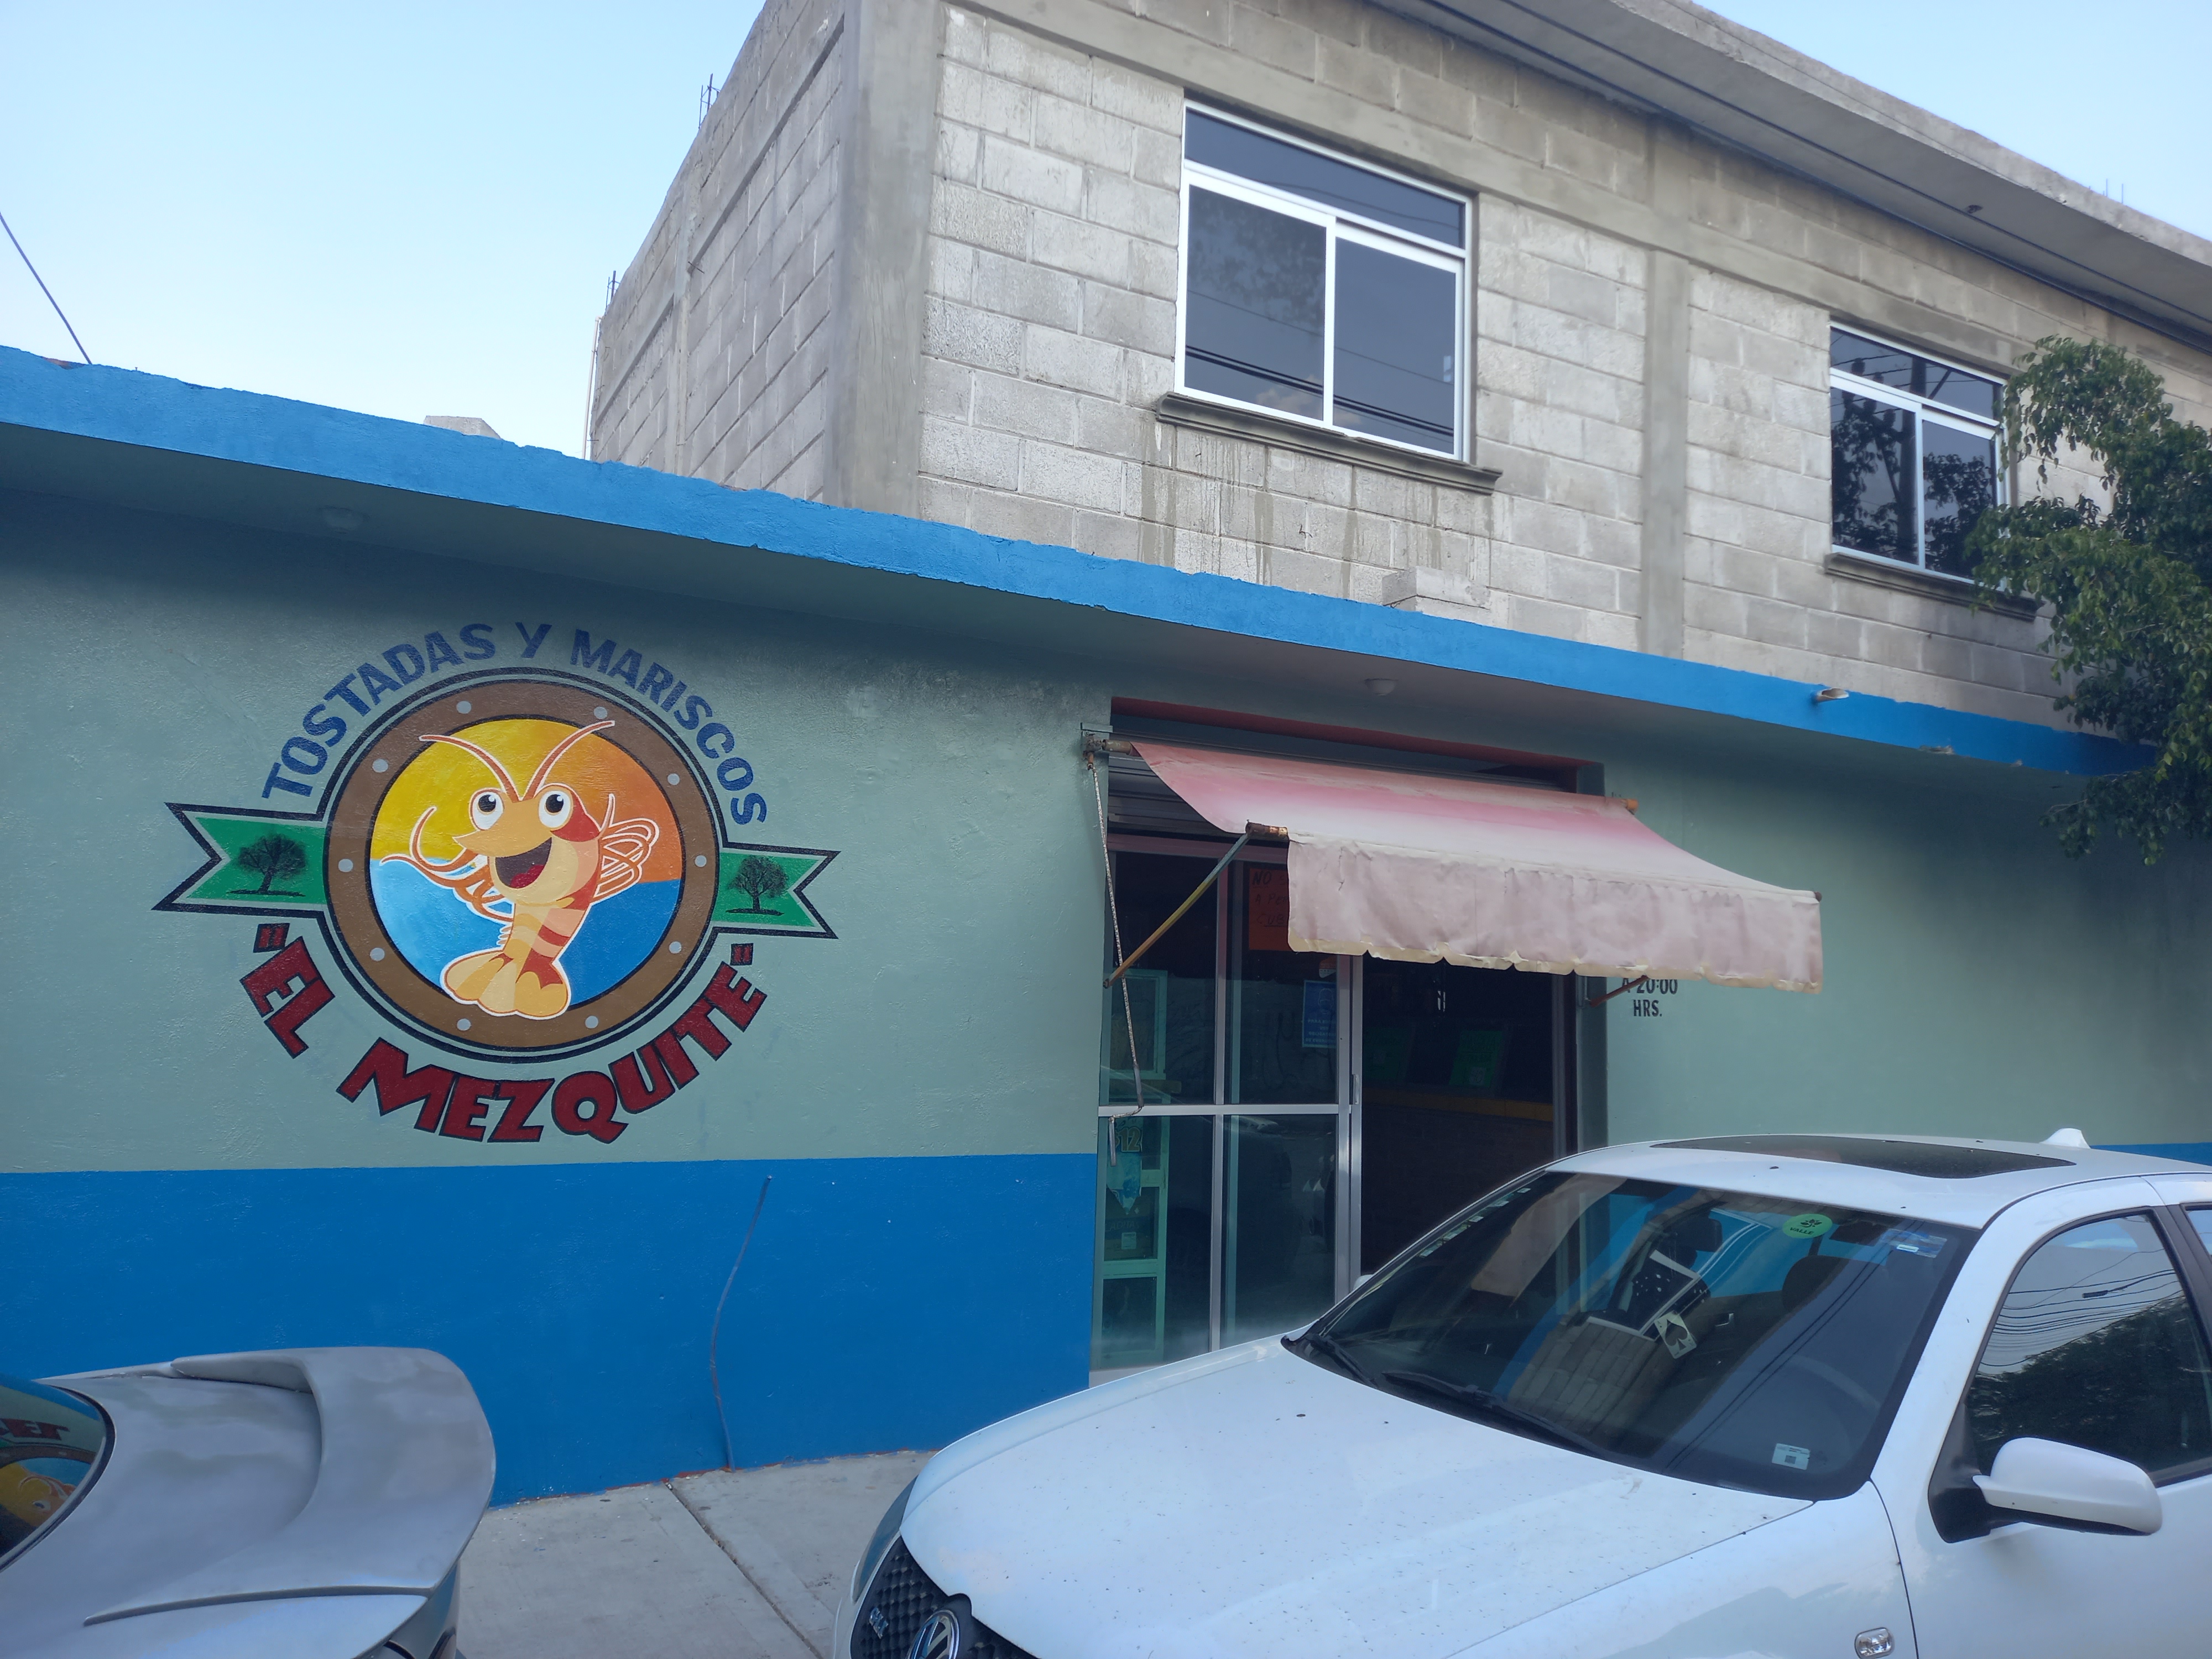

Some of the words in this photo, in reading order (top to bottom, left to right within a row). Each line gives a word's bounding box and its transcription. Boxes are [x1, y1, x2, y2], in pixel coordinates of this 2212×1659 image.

[260, 623, 496, 800] TOSTADAS
[515, 621, 553, 659] Y
[570, 628, 768, 825] MARISCOS
[1252, 871, 1271, 885] NO
[1257, 912, 1286, 925] CUB
[1634, 999, 1662, 1017] HRS.
